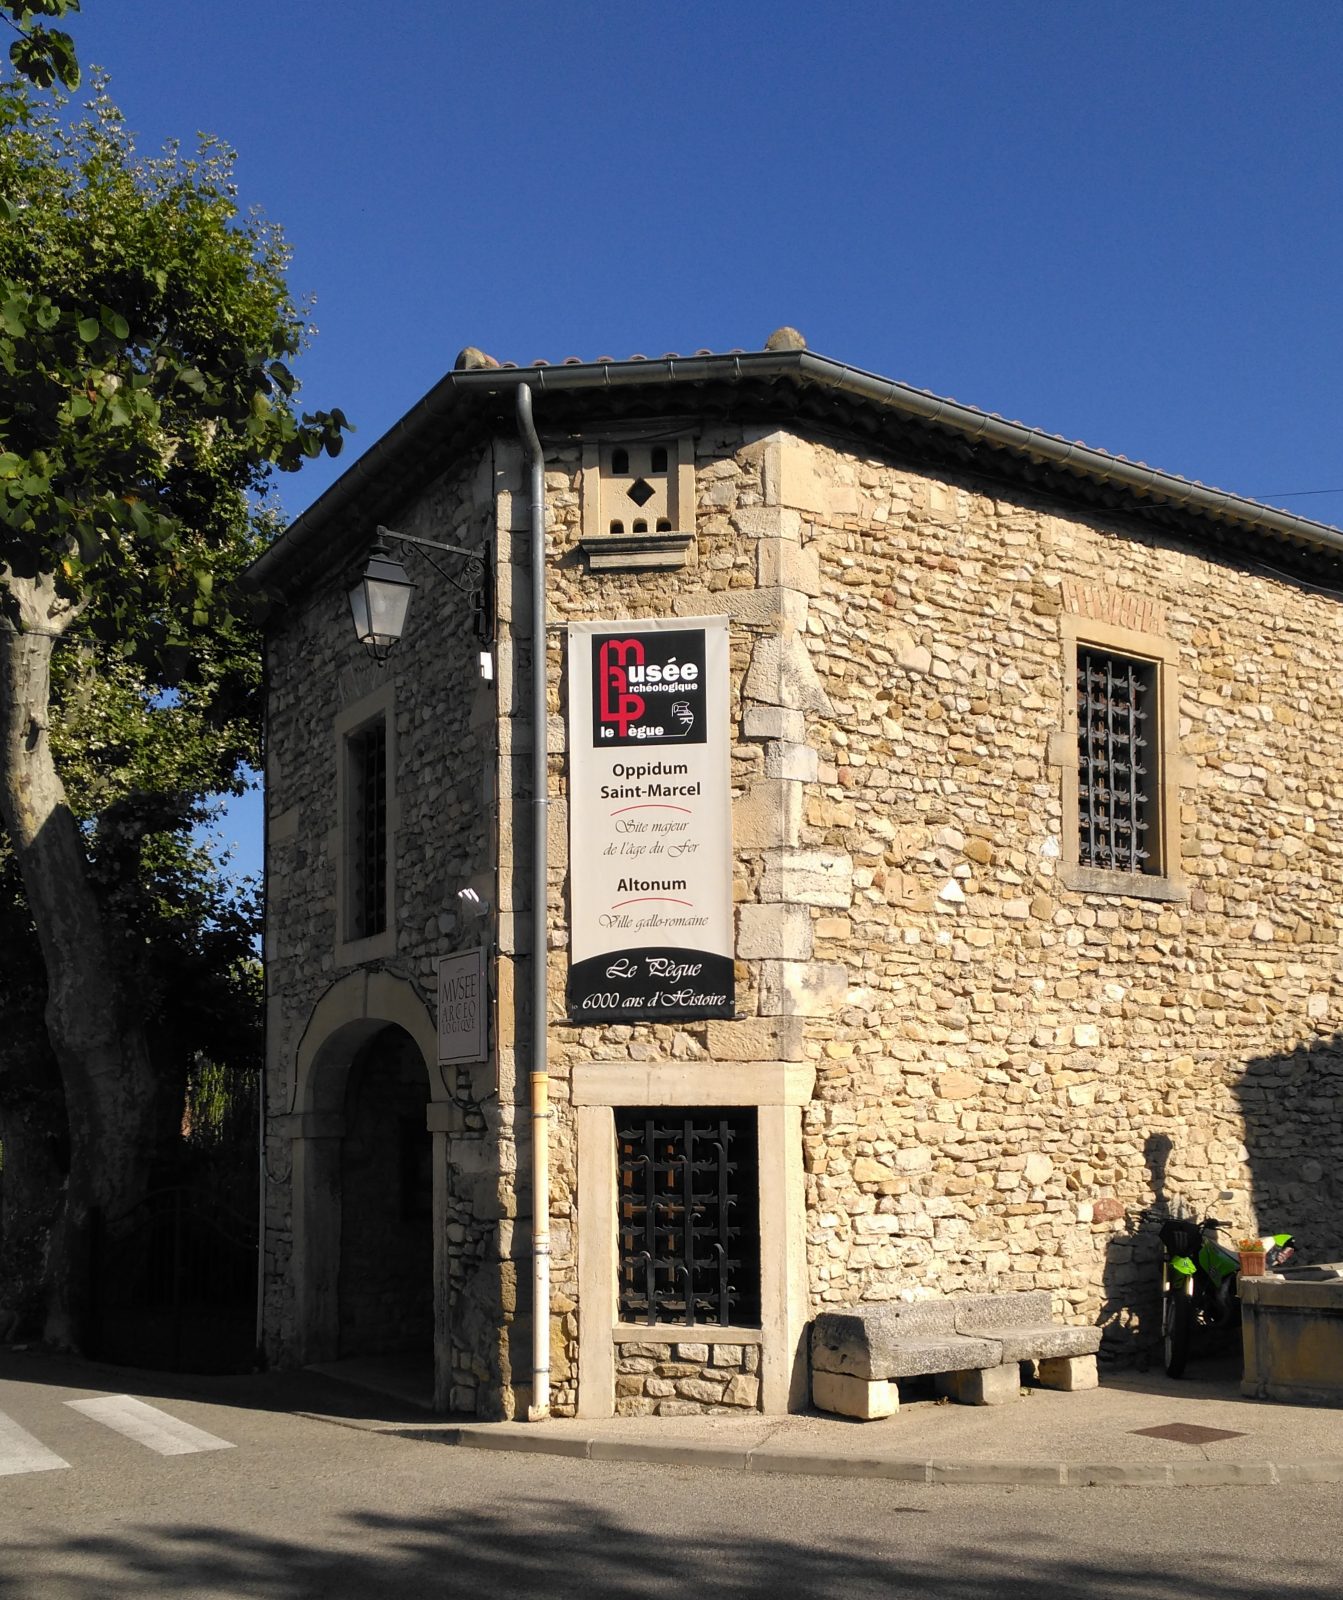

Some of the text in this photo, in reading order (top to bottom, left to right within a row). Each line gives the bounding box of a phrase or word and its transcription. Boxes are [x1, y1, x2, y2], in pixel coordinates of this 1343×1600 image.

[600, 726, 615, 738] le
[612, 762, 688, 779] Oppidum
[600, 781, 701, 799] Saint-Marcel
[615, 819, 690, 837] Site majeur
[603, 839, 700, 859] de l'âge du Fer
[617, 878, 687, 892] Altonum
[598, 914, 709, 933] Ville gallo-romaine
[605, 956, 703, 984] Le Pègue
[582, 988, 727, 1009] 6000 ans d'Histoire
